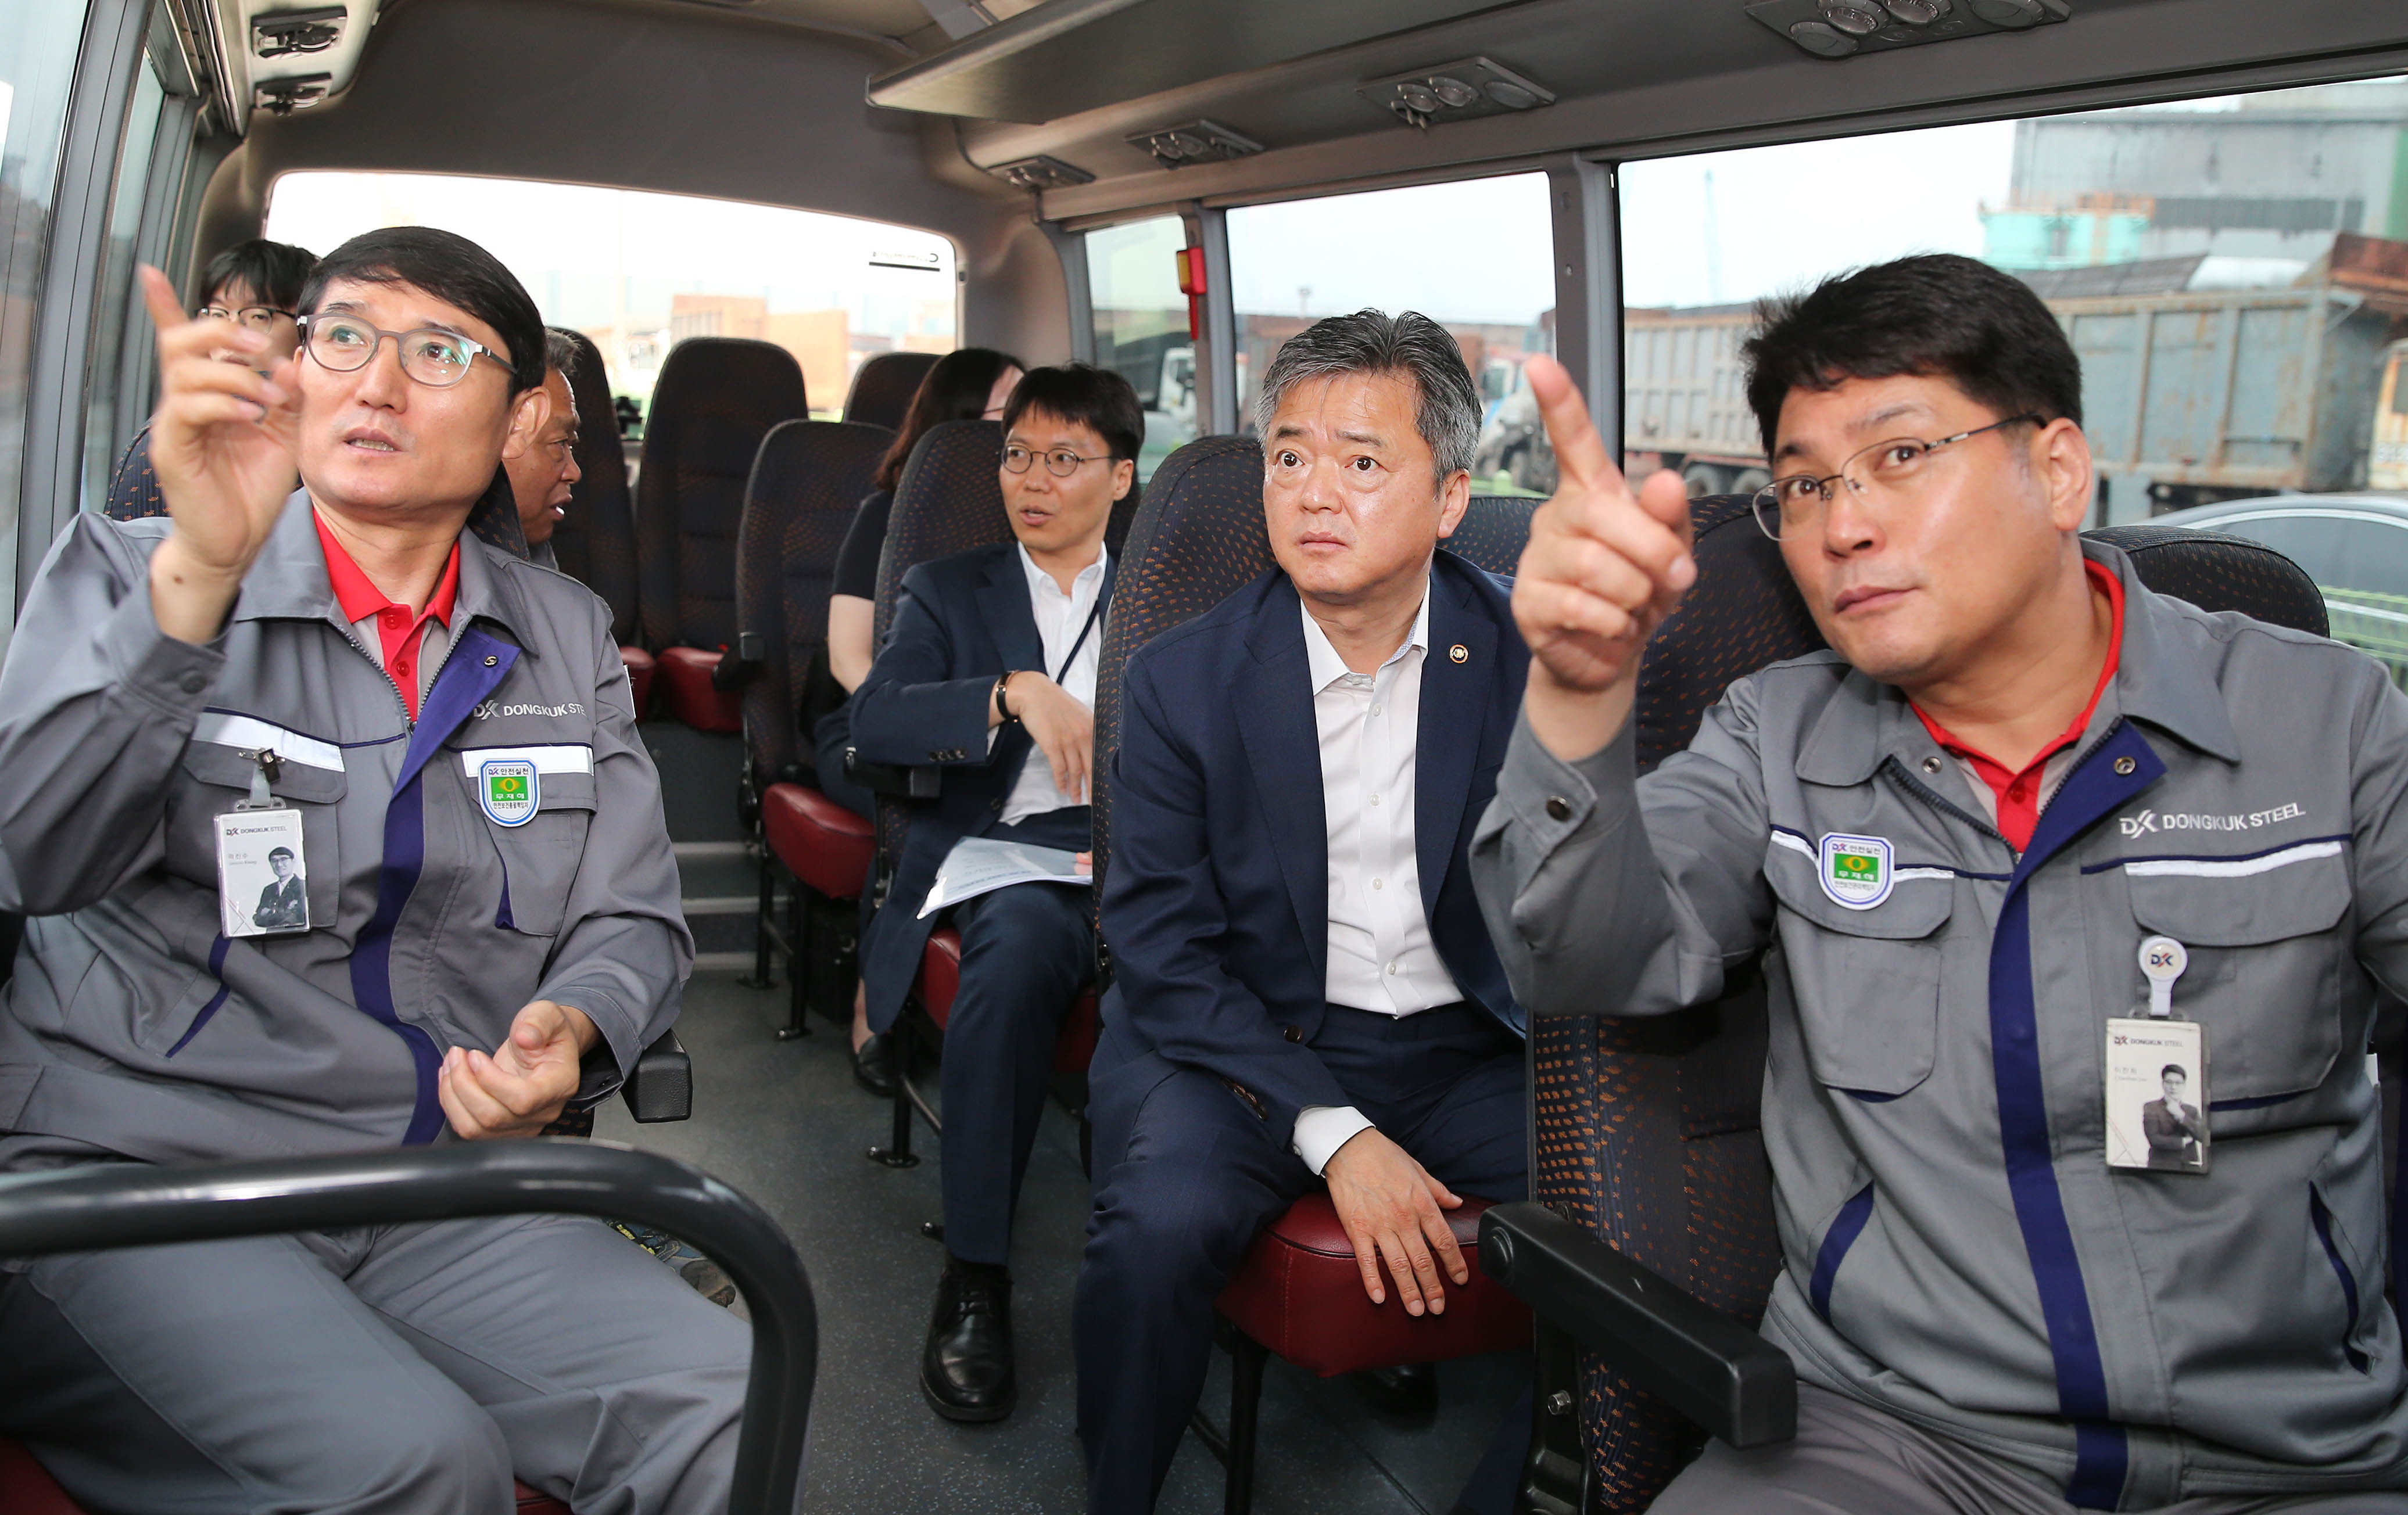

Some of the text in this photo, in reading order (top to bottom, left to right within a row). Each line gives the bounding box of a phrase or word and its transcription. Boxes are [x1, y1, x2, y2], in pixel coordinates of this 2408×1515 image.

[504, 703, 568, 717] DONGKUK
[500, 767, 529, 776] 안전실천
[2119, 802, 2306, 839] DK DONGKUK STEEL
